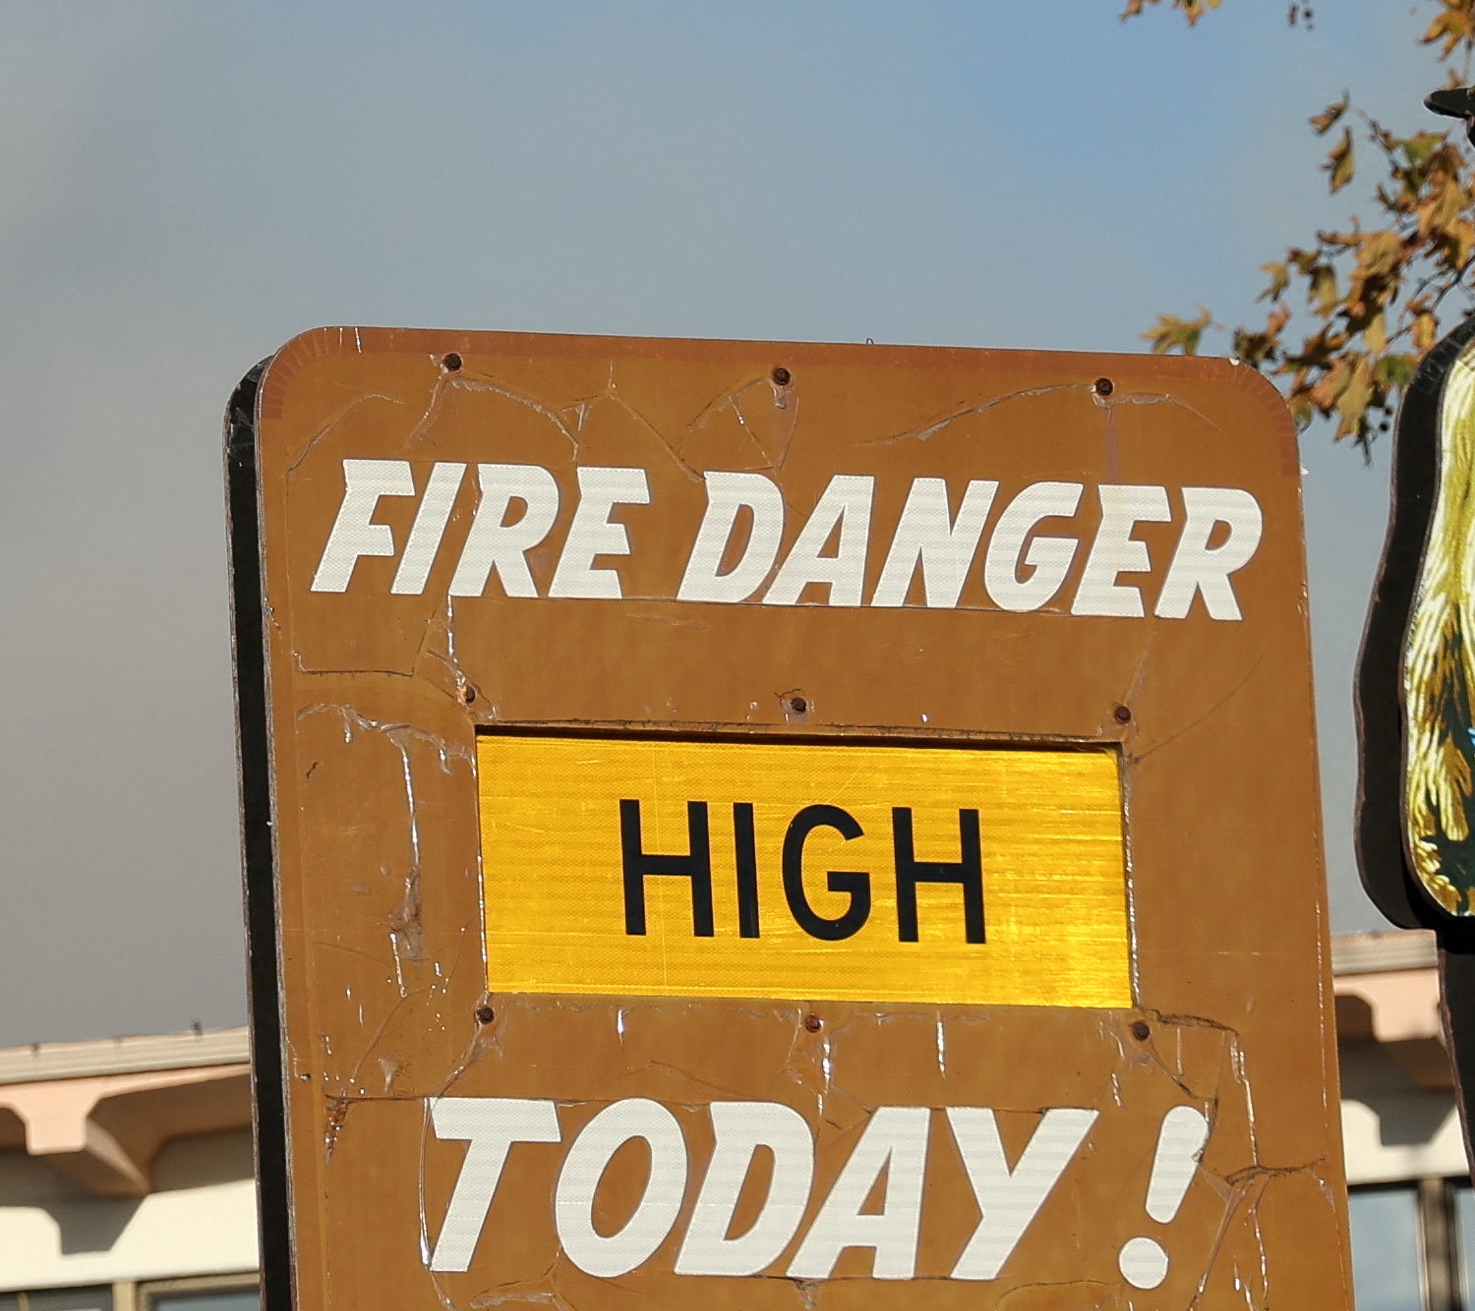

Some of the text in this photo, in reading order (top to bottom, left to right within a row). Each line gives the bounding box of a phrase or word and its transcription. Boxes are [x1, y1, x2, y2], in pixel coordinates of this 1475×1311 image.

[309, 457, 1264, 622] FIRE DANGER
[617, 797, 986, 945] HIGH
